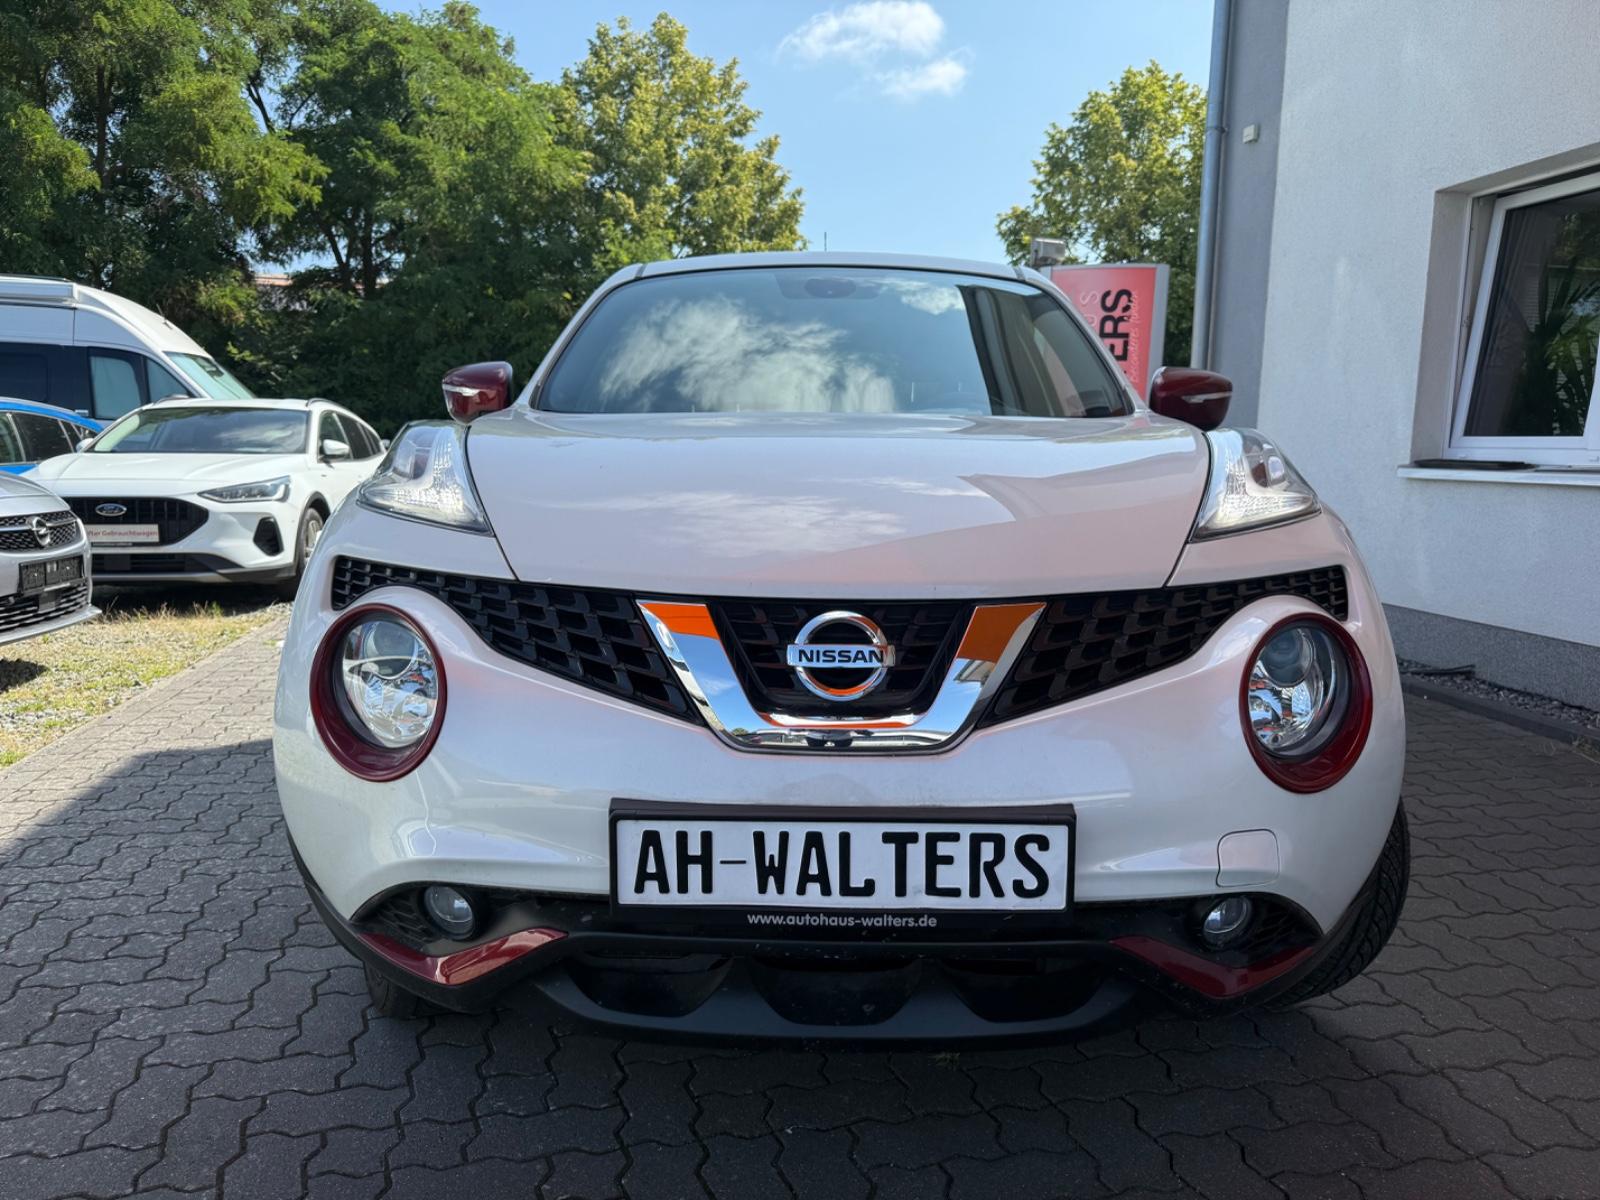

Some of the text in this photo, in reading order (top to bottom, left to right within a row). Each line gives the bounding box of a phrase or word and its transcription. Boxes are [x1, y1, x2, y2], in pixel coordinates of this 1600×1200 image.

[1100, 289, 1133, 374] ERS
[798, 650, 884, 663] NISSAN
[633, 829, 1050, 899] AH-WALTERS
[747, 913, 938, 928] www.autohaus-walters.de
